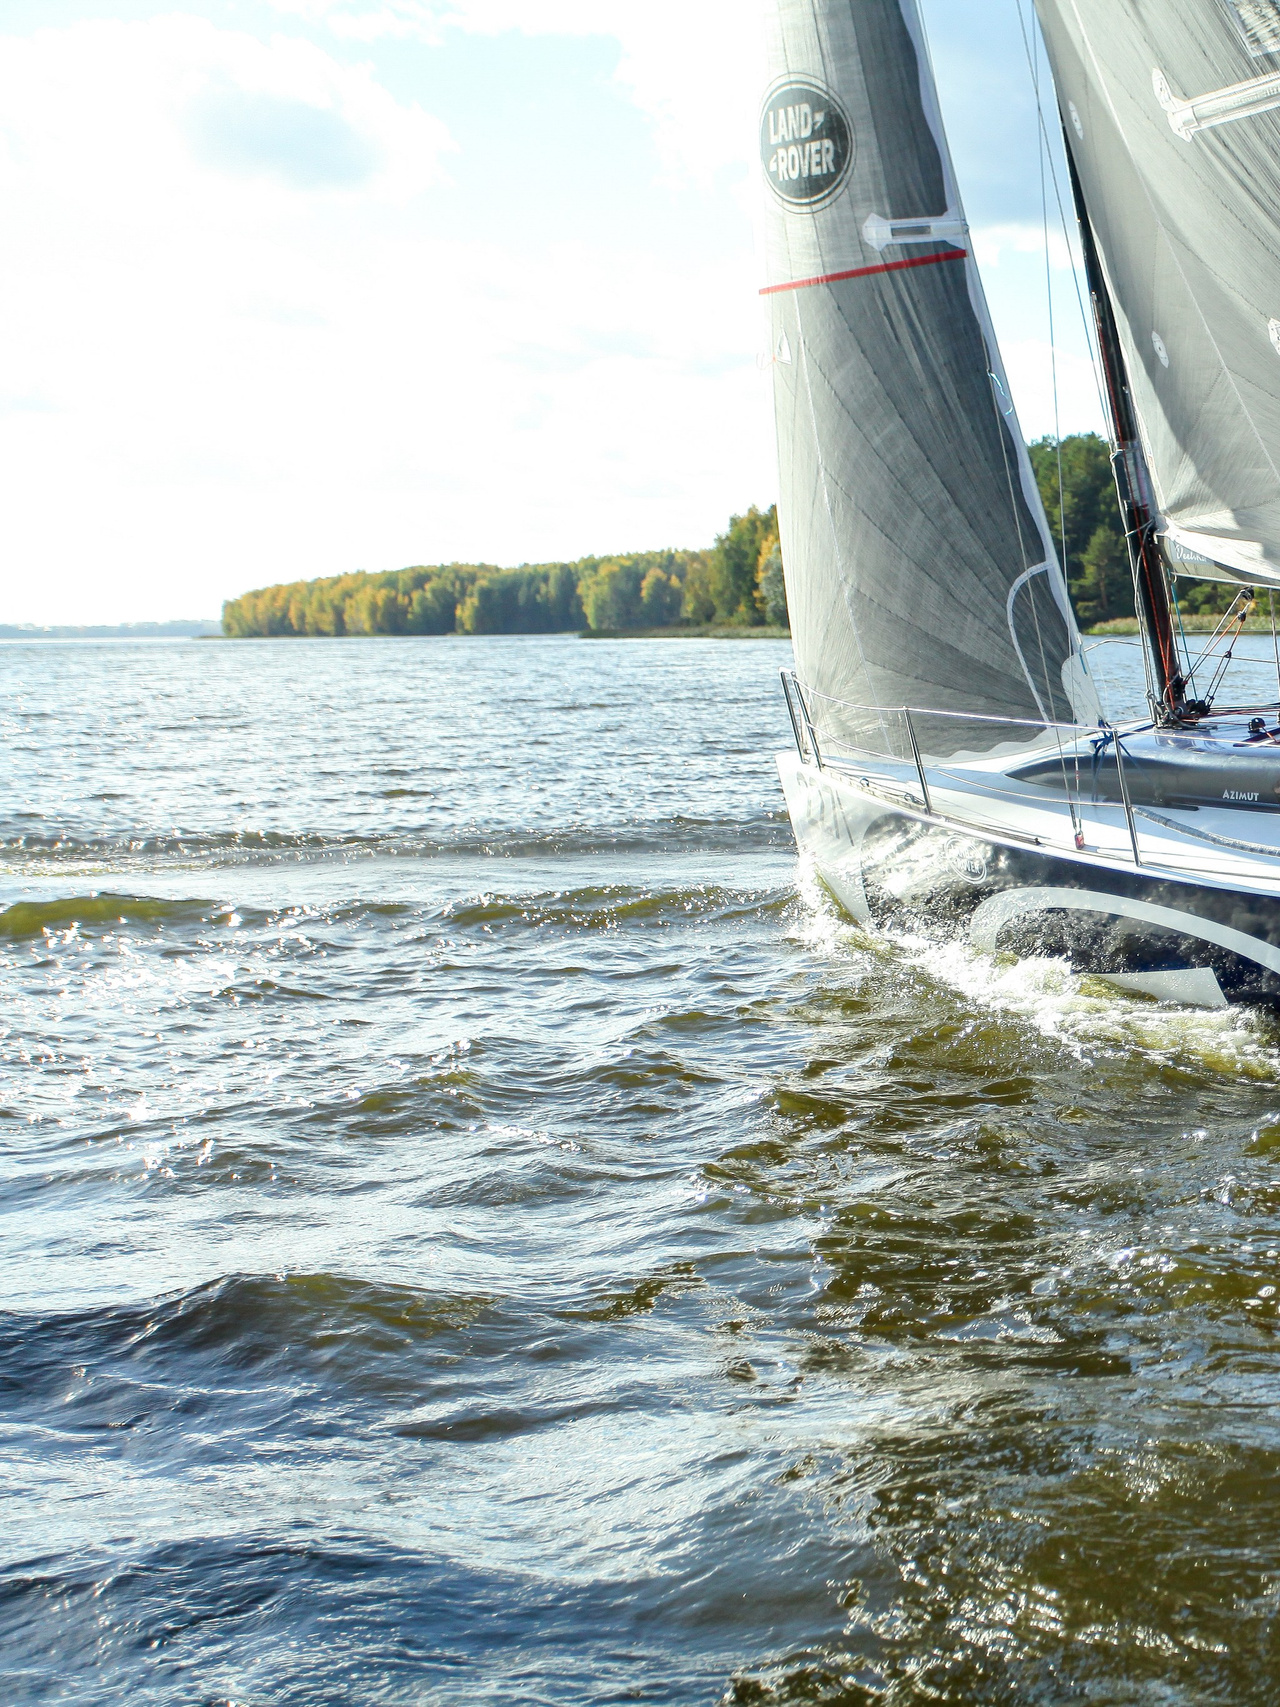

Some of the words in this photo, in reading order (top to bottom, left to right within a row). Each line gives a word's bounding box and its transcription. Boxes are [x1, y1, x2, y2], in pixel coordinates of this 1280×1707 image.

[768, 103, 813, 145] LAND
[776, 138, 835, 182] ROVER
[1222, 789, 1260, 802] AZIMUT
